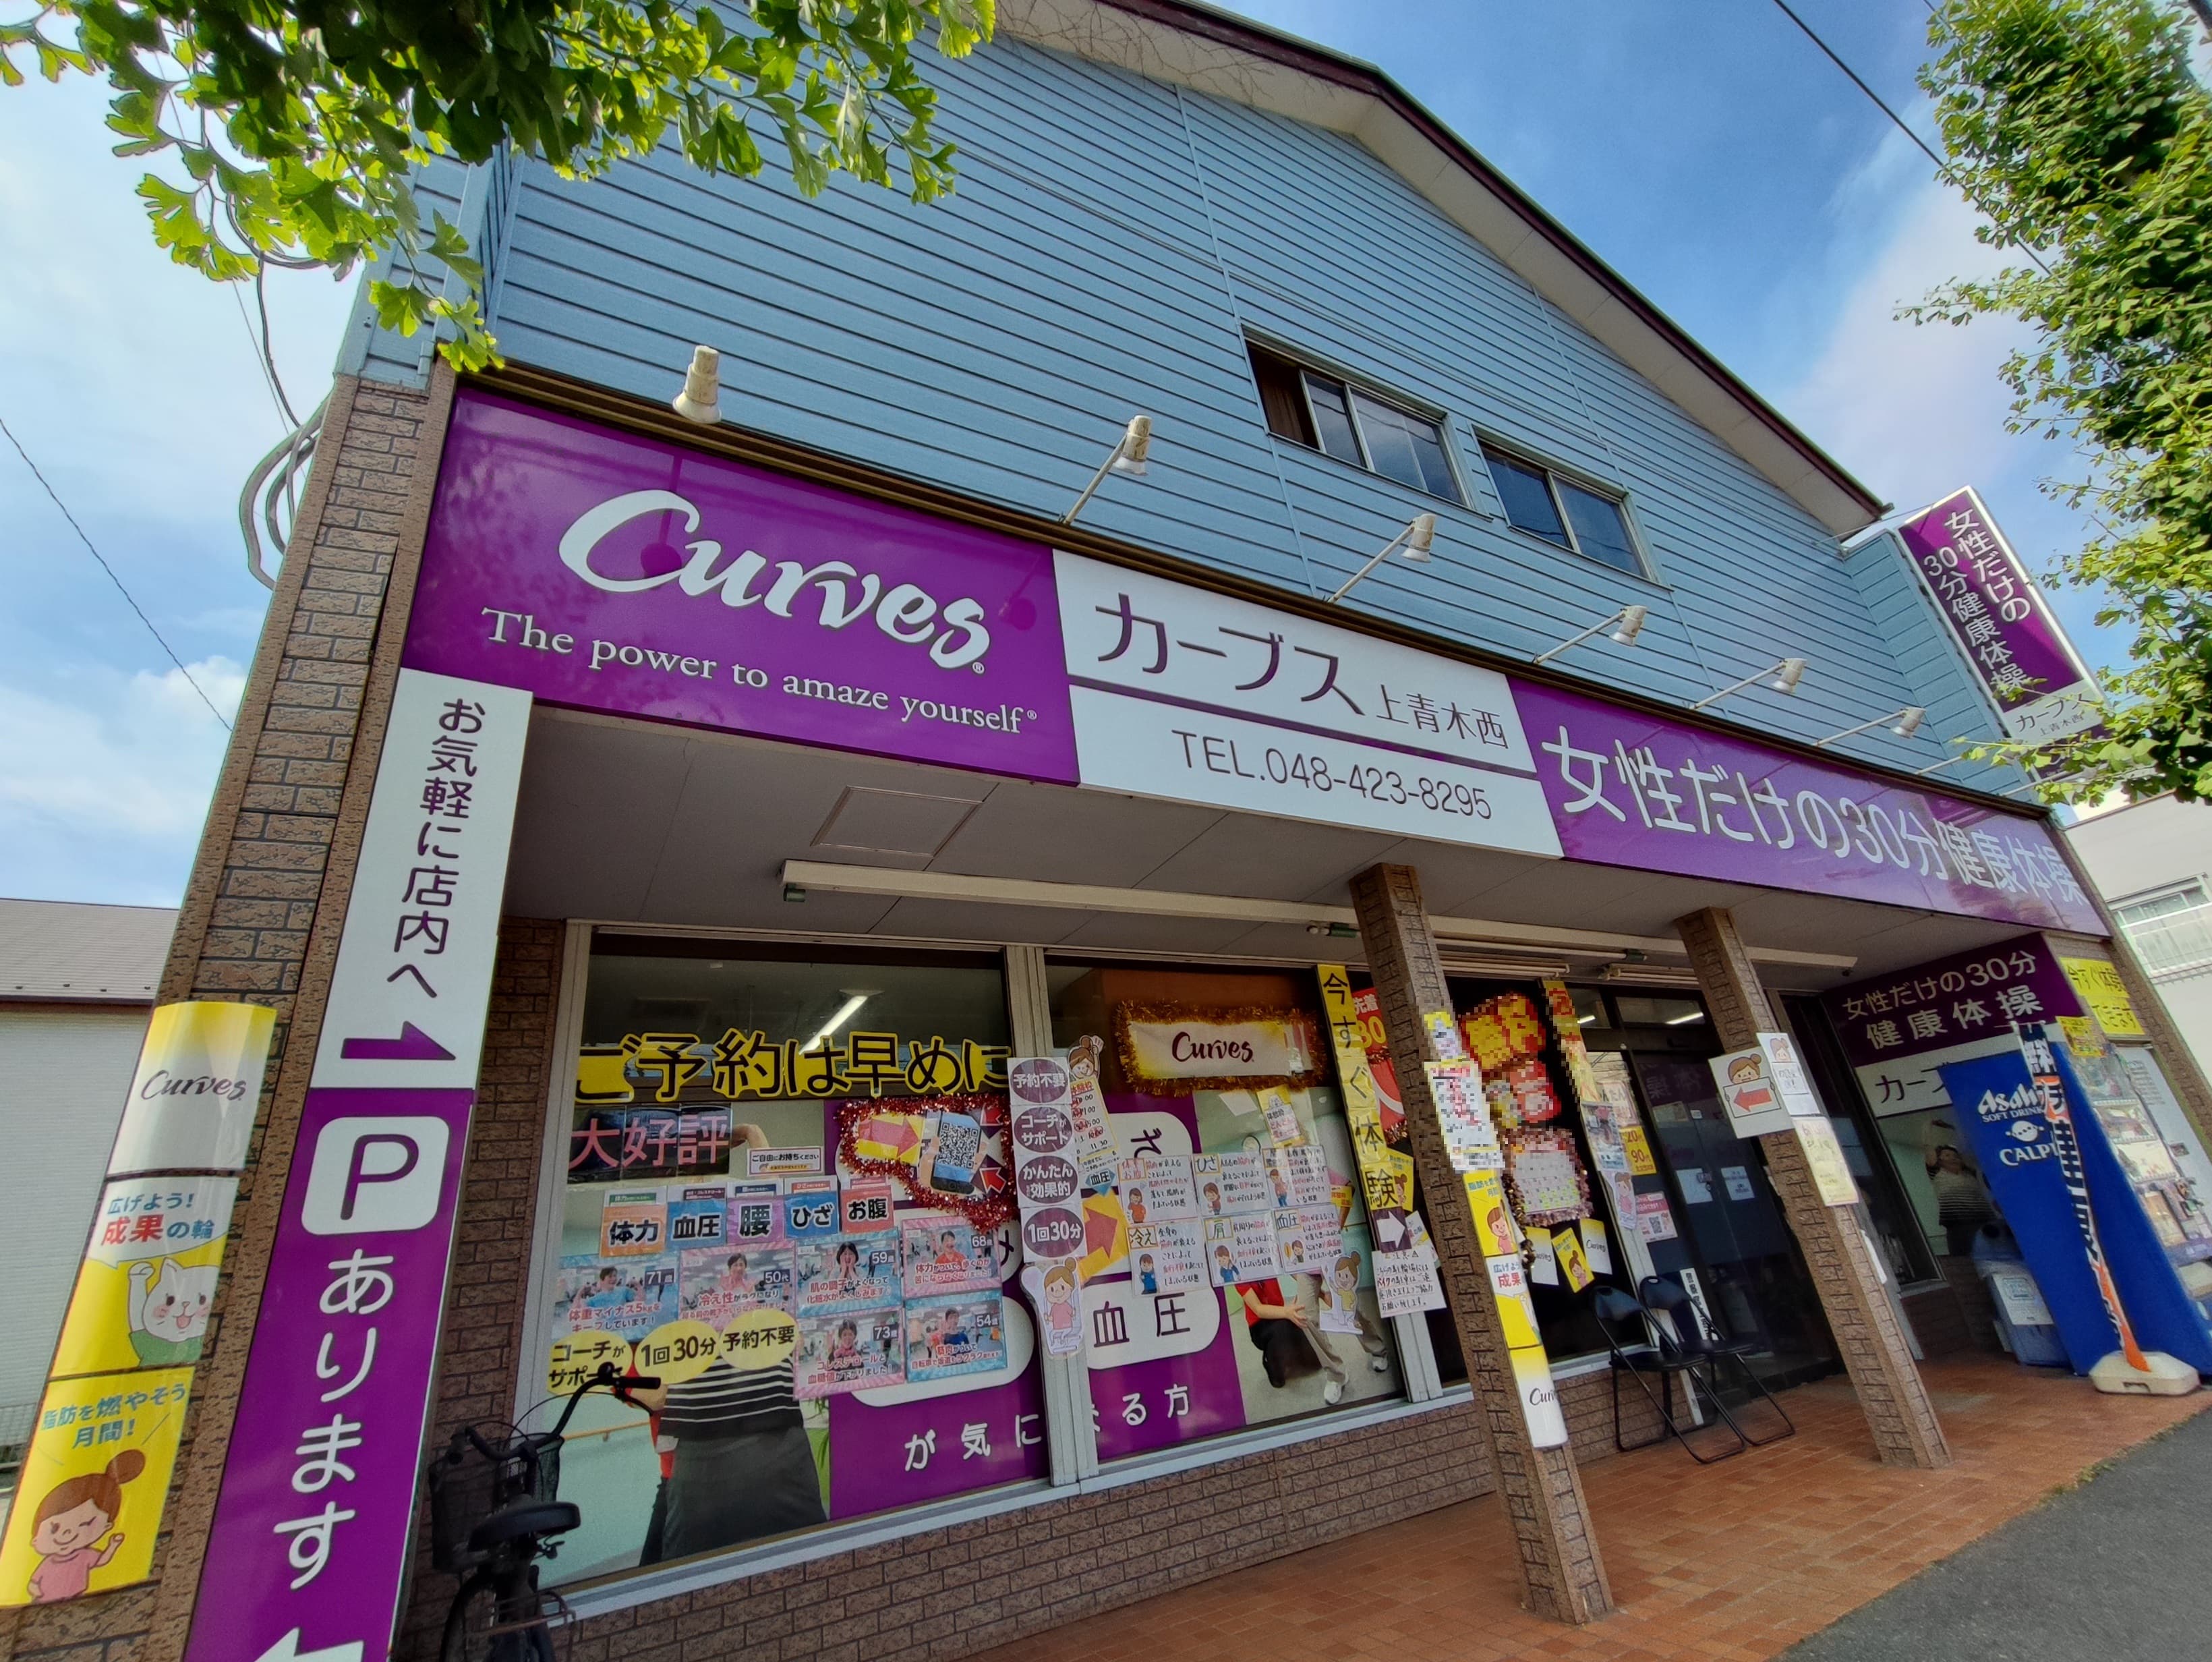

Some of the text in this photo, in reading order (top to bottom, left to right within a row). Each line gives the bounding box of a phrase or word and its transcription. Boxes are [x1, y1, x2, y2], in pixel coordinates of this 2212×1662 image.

[558, 490, 991, 669] Curves
[1944, 509, 2031, 623] 女性だけの
[482, 606, 1025, 735] The power to amaze yourself
[1095, 592, 1509, 749] カーブス 上青木西
[1171, 729, 1492, 820] TEL.048-423-8295
[1541, 724, 2085, 907] 女性だけの30分健康体操
[386, 697, 486, 998] お気軽に店内へ
[1843, 950, 2037, 1021] 女性だけの30分
[1866, 985, 2043, 1051] 健康体操
[1171, 1031, 1254, 1062] Curves
[575, 1028, 1010, 1100] ご予約は早めに
[141, 1070, 246, 1101] Curves
[1014, 1073, 1066, 1088] 予約不要
[1323, 973, 1397, 1207] 今すぐ体験
[1978, 1083, 2039, 1114] Asah
[1982, 1106, 2044, 1122] SOFT DRINK
[1021, 1114, 1066, 1129] コーチが
[570, 1114, 729, 1168] 大好評
[1022, 1130, 1068, 1145] サポート
[752, 1153, 819, 1162] ご自由にお持ちください
[2000, 1143, 2059, 1166] CALPI
[341, 1134, 419, 1221] P
[1022, 1165, 1073, 1180] かんたん
[1091, 1171, 1110, 1185] 血圧
[739, 1205, 771, 1237] 腰
[792, 1203, 833, 1228] ひざ
[847, 1198, 887, 1220] お腹
[102, 1214, 214, 1246] 成果の輪
[609, 1220, 659, 1244] 体力
[672, 1215, 720, 1239] 血圧
[1028, 1221, 1082, 1243] 1回30分
[765, 1271, 789, 1282] 50代
[1498, 1273, 1521, 1288] 成果
[1093, 1292, 1191, 1348] 血圧
[552, 1341, 626, 1363] コーチが
[641, 1336, 716, 1367] 1回30分
[723, 1325, 794, 1351] 予約不要
[41, 1383, 185, 1431] 脂肪を燃やそう
[274, 1249, 395, 1591] あります
[905, 1414, 1043, 1472] が気に
